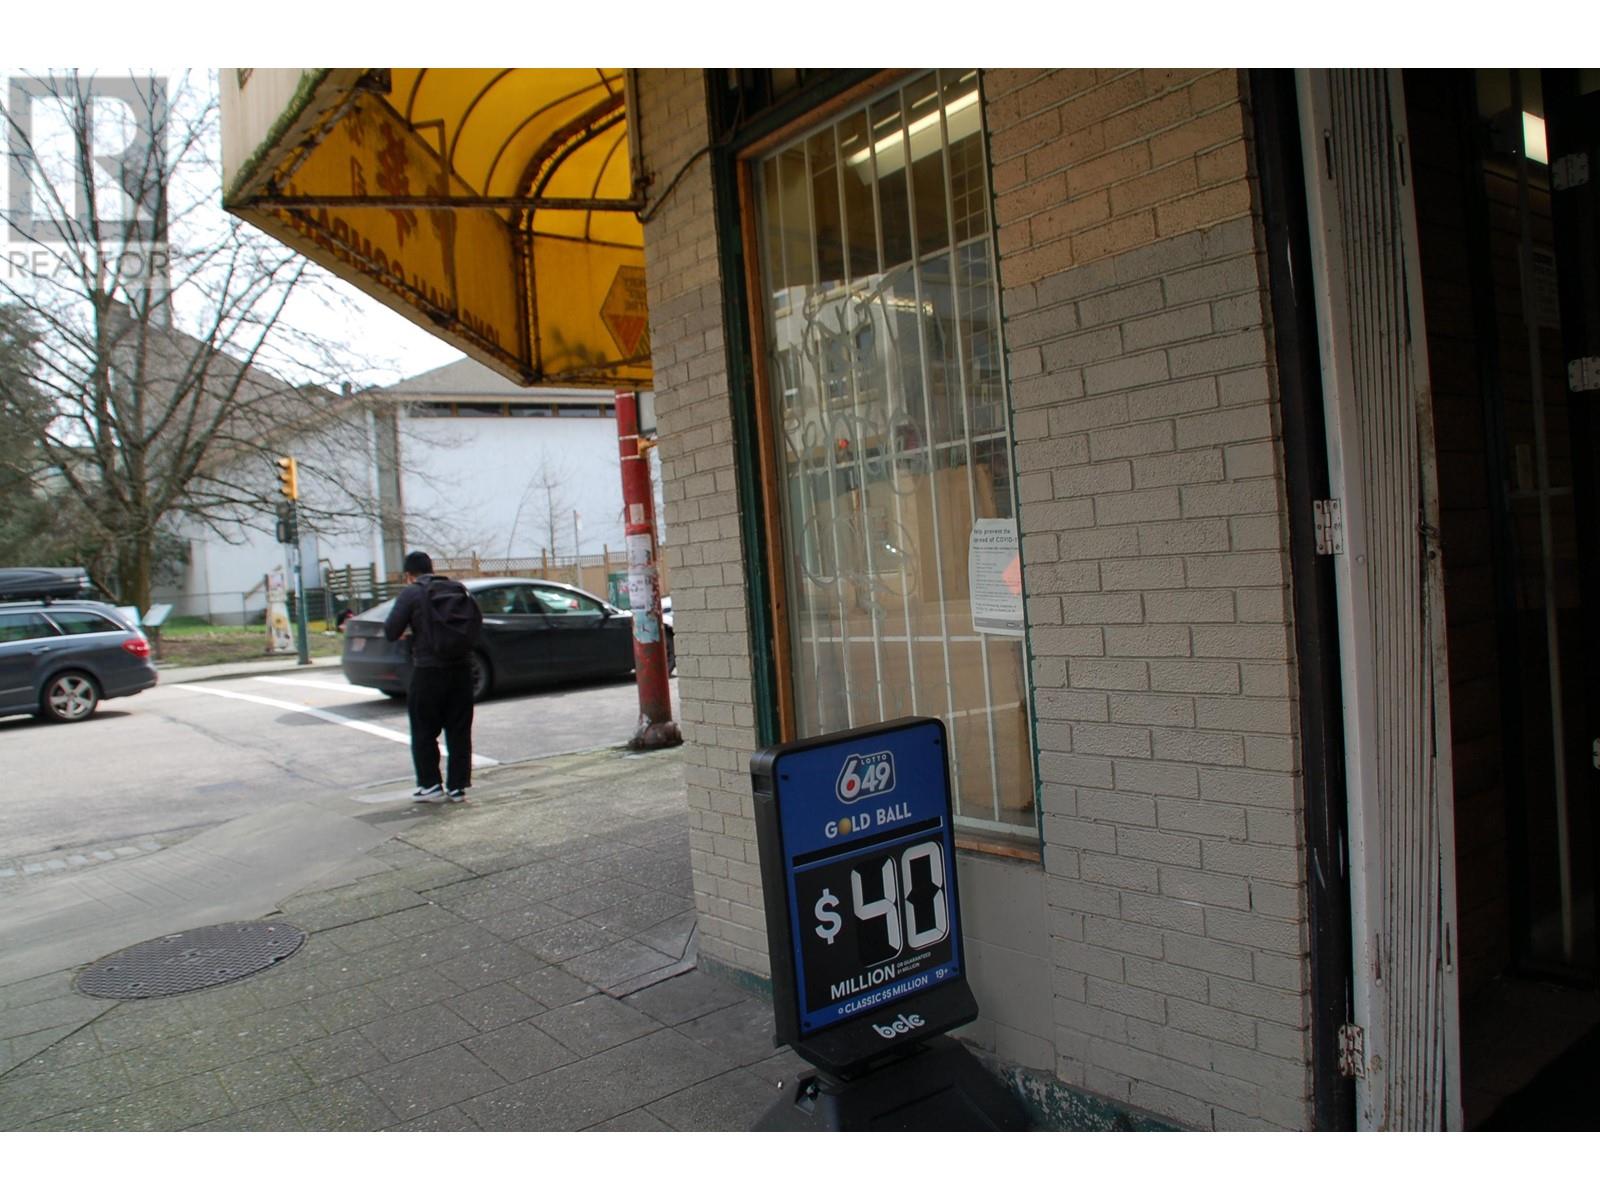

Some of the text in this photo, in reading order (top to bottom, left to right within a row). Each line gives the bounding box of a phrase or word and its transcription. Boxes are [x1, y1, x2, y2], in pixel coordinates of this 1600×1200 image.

[861, 754, 887, 765] LOTTO
[825, 802, 912, 838] GOLD BALL
[830, 963, 896, 1000] MILLION
[935, 968, 949, 979] 19+
[844, 976, 928, 1014] CLASSIC $5 MILLION
